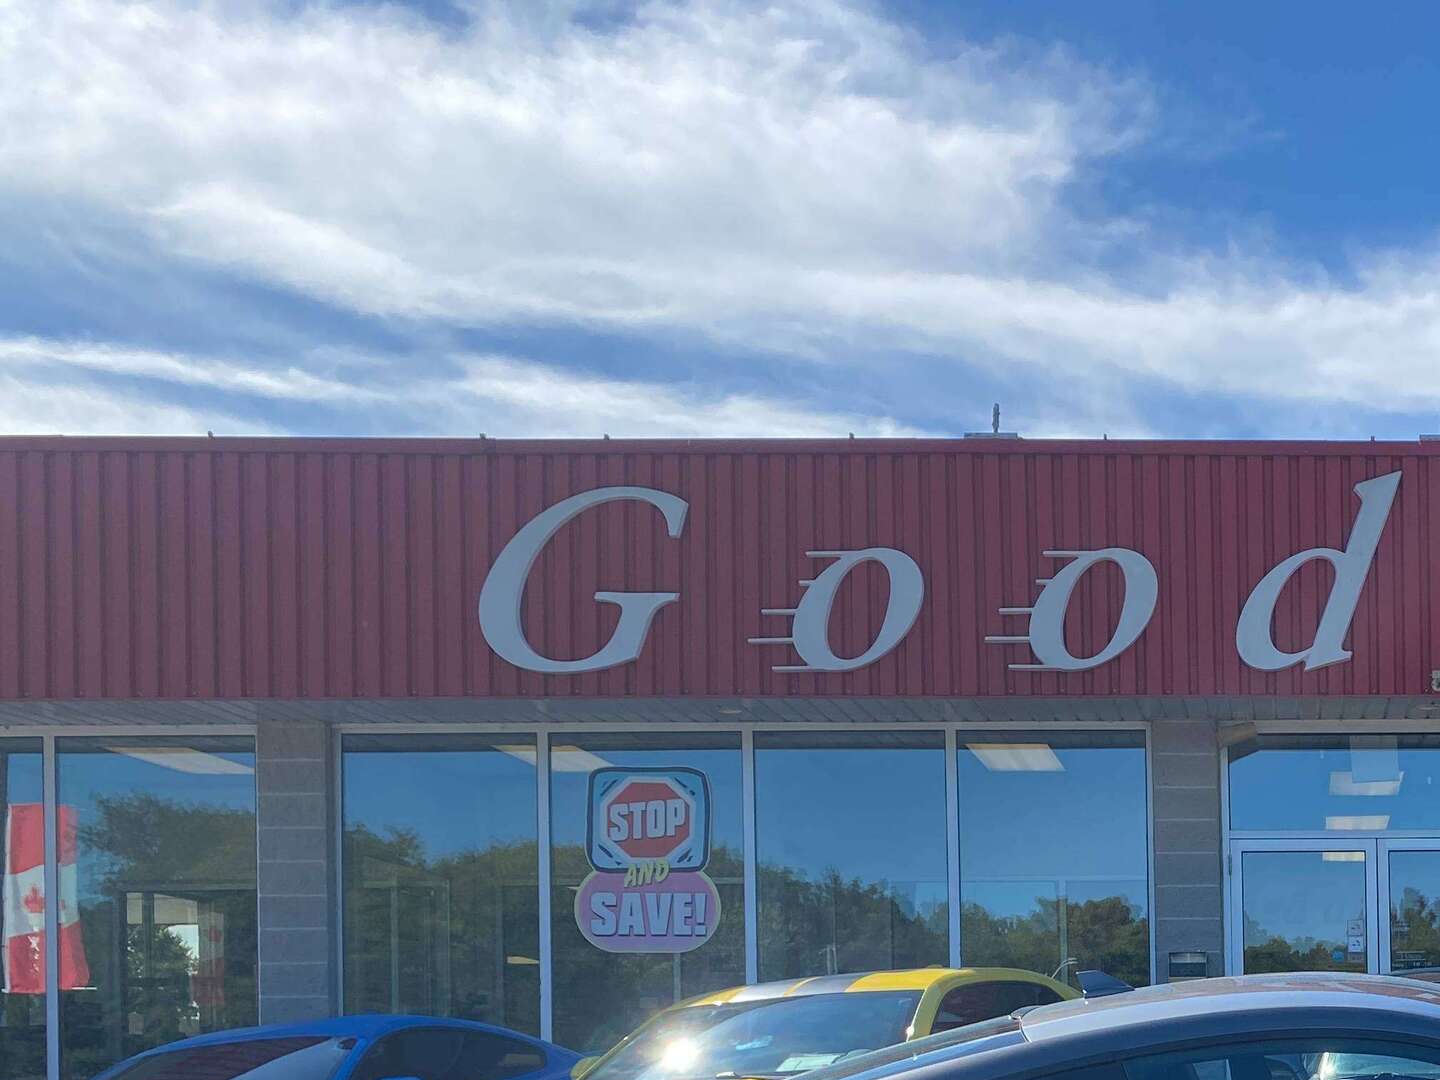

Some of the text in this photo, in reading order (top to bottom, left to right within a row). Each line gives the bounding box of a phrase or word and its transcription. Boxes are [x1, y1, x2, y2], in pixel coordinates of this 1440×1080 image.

[608, 799, 686, 842] STOP
[624, 859, 671, 889] AND
[590, 892, 709, 937] SAVE!
